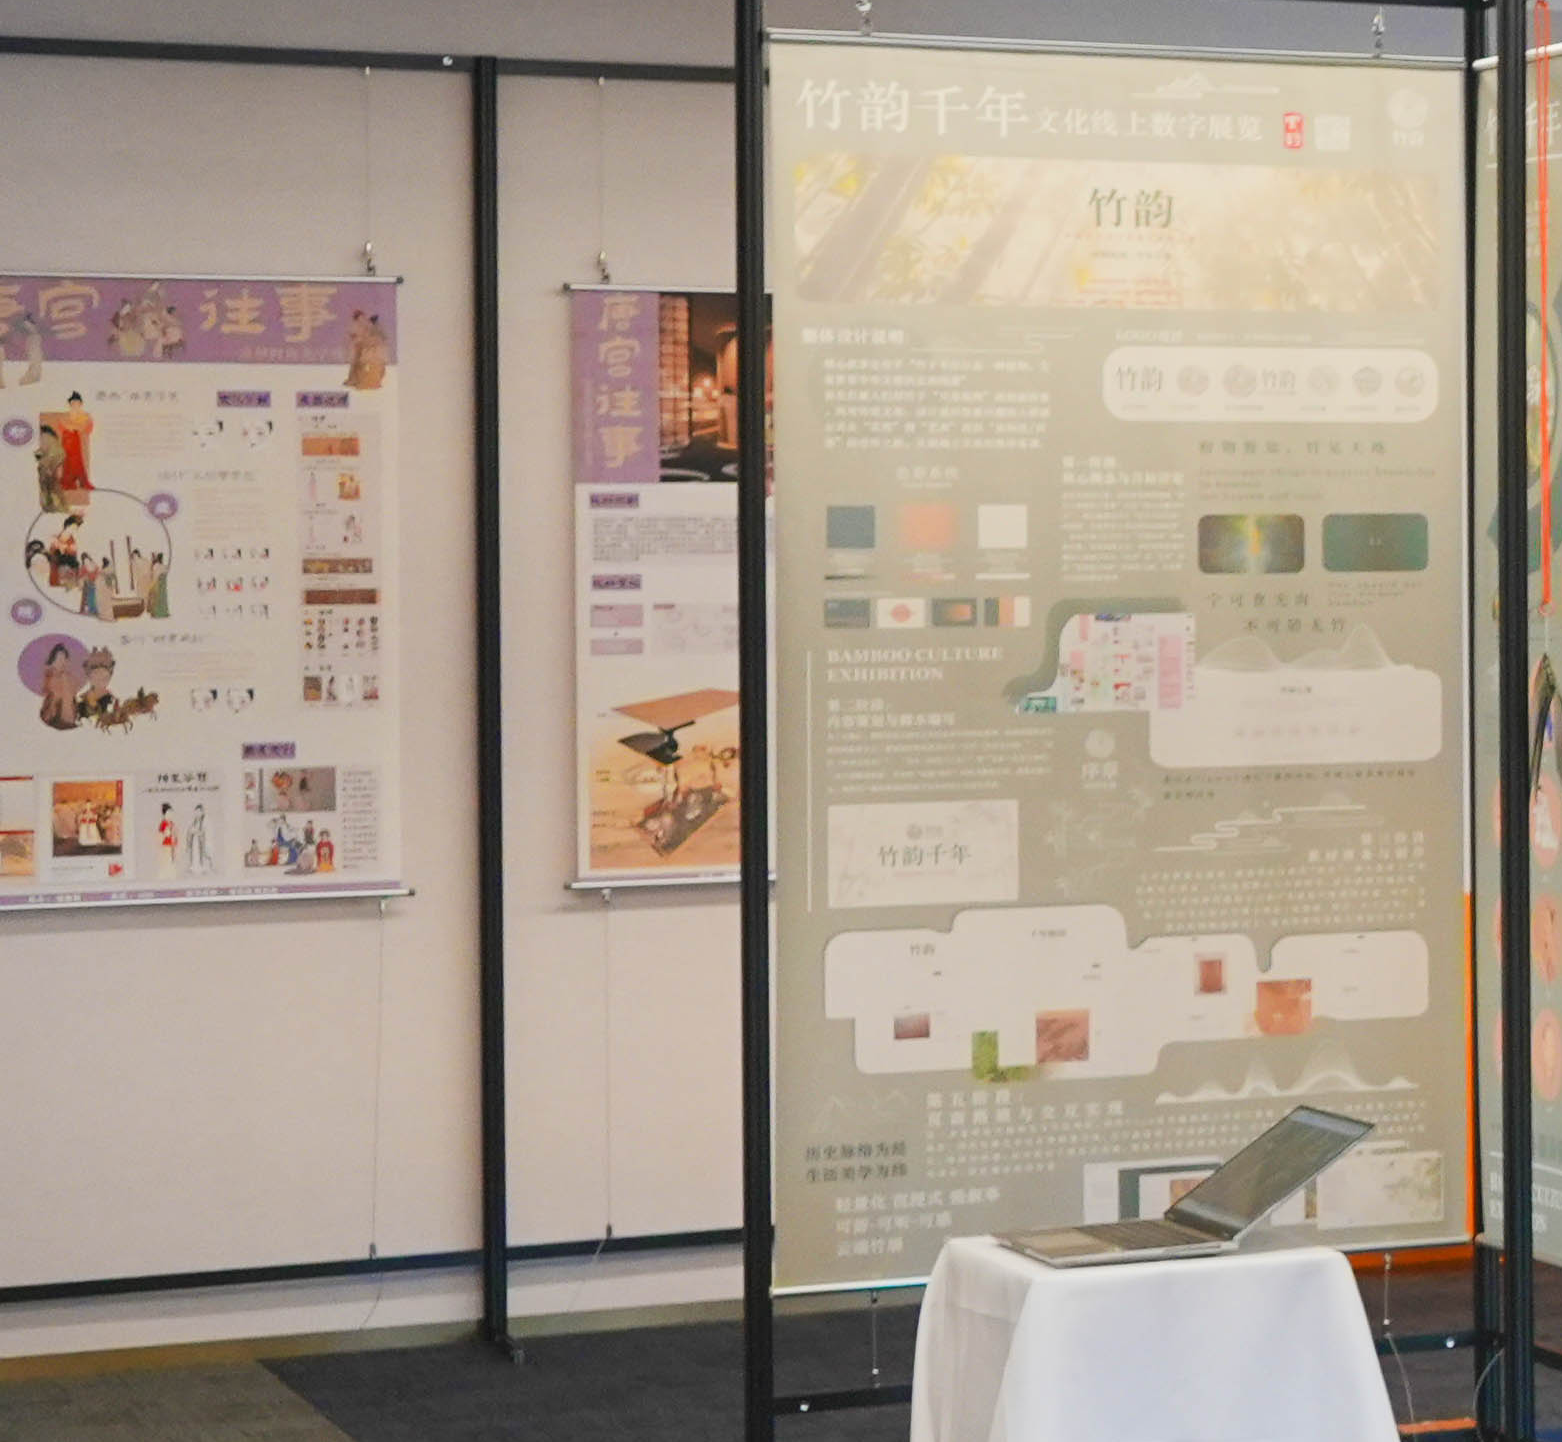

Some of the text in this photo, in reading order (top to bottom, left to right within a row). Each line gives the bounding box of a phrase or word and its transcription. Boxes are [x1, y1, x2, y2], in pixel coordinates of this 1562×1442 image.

[798, 79, 1030, 138] 竹韵千年
[1032, 108, 1263, 143] 文化线上数字展览
[1088, 187, 1173, 230] 竹韵
